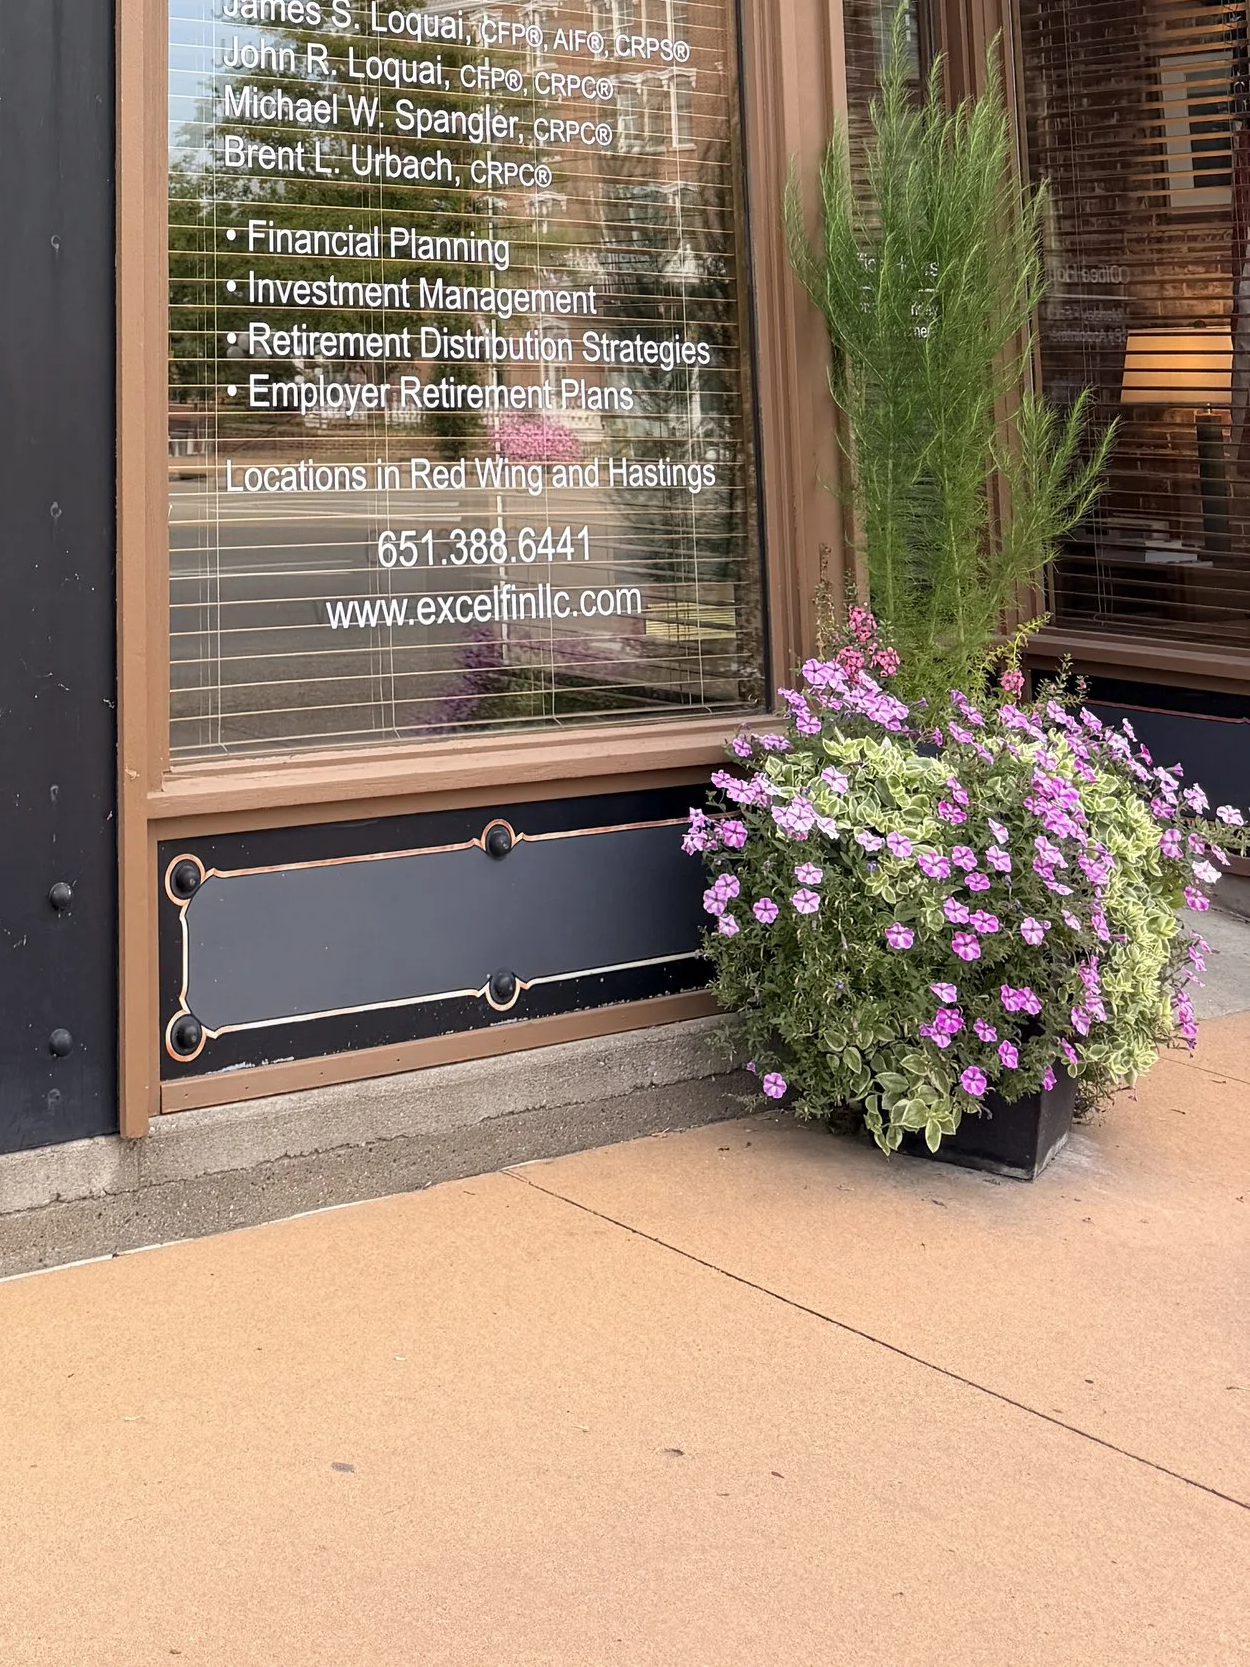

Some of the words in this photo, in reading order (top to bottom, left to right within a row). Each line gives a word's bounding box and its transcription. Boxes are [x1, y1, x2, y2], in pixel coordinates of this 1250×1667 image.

[223, 38, 297, 73] John
[305, 44, 337, 77] R.
[349, 46, 450, 89] Loquai,
[534, 70, 614, 101] CRPC®
[224, 87, 338, 124] Michael
[348, 94, 384, 129] W.
[395, 100, 525, 147] Spangler,
[533, 117, 614, 148] CRPC®
[224, 136, 305, 172] Brent
[314, 141, 339, 174] L.
[352, 143, 460, 187] Urbach,
[470, 159, 553, 189] CRPC®
[248, 220, 379, 258] Financial
[389, 226, 511, 271] Planning
[248, 271, 410, 308] Investment
[419, 278, 597, 319] Management
[249, 322, 411, 358] Retirement
[420, 327, 574, 361] Distribution
[582, 331, 711, 371] Strategies
[249, 374, 390, 415] Employer
[400, 376, 551, 410] Retirement
[560, 378, 634, 411] Plans
[226, 459, 367, 493] Locations
[377, 459, 400, 490] in
[410, 458, 466, 490] Red
[475, 457, 544, 496] Wing
[551, 458, 599, 488] and
[609, 457, 716, 493] Hastings
[378, 525, 591, 568] 651.388.6441
[325, 585, 642, 629] www.excelfinllc.com
